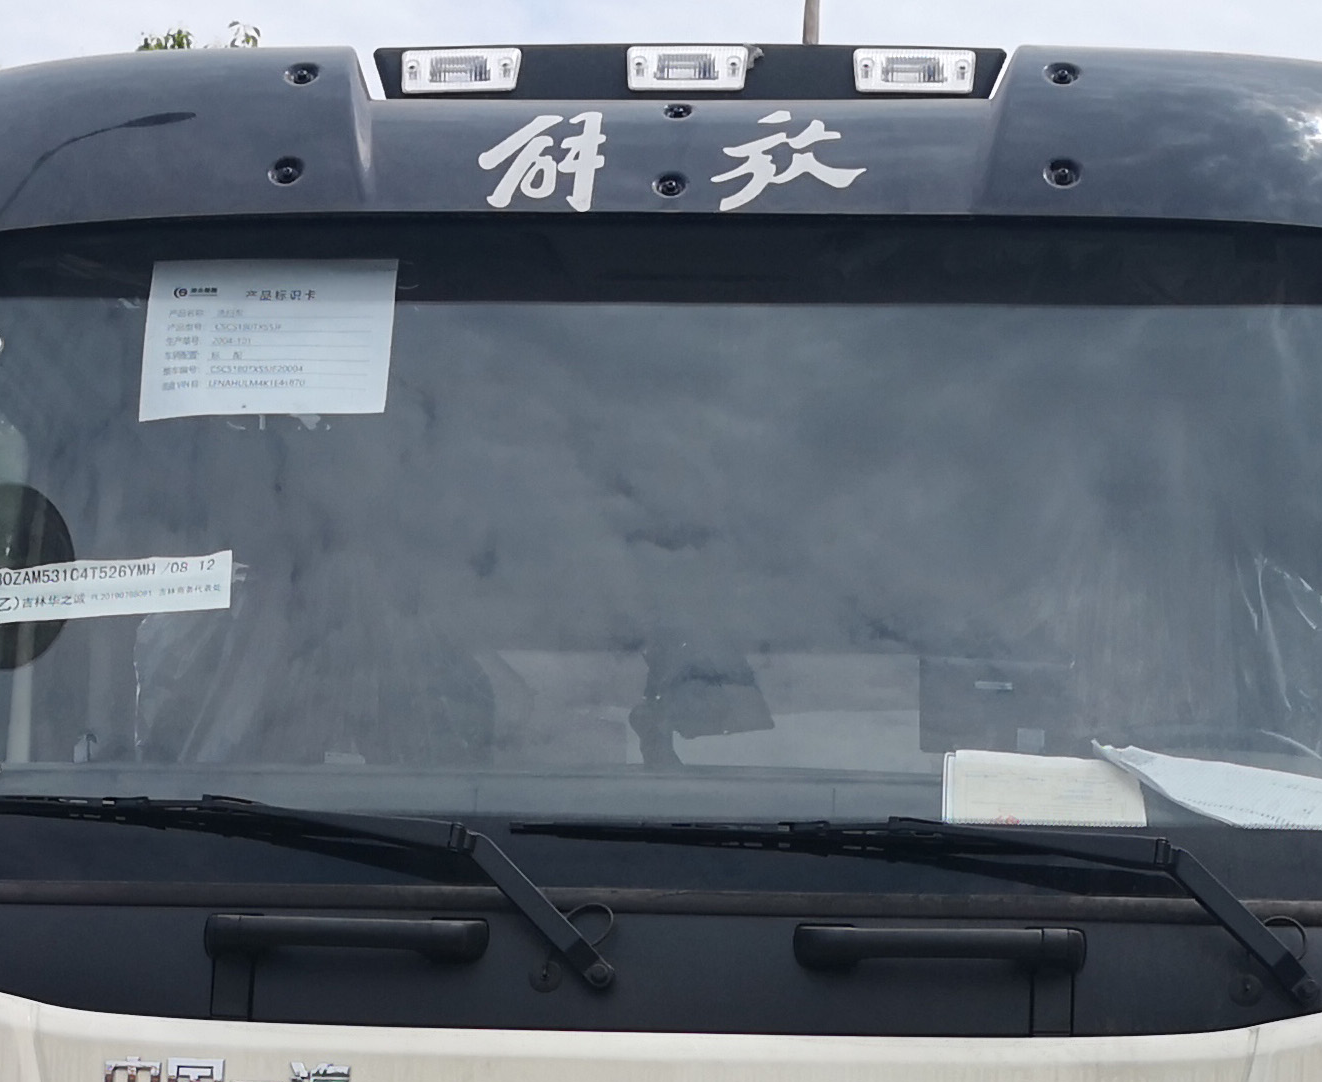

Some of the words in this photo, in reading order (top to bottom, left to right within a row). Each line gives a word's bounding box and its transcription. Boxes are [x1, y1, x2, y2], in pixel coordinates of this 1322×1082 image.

[245, 289, 317, 301] 产品标识卡
